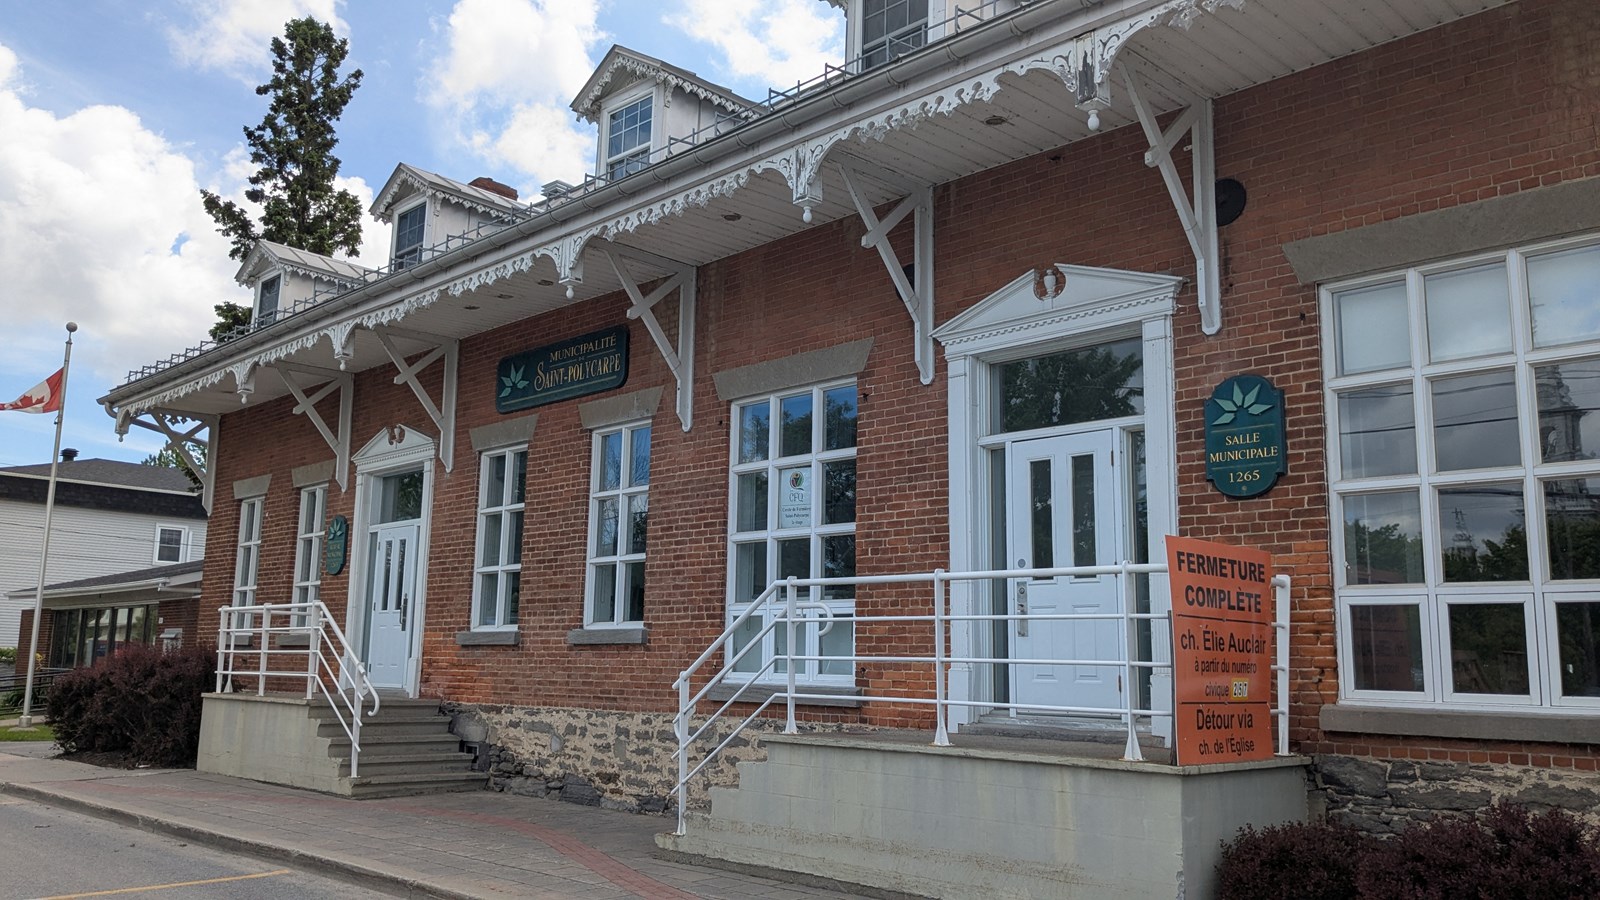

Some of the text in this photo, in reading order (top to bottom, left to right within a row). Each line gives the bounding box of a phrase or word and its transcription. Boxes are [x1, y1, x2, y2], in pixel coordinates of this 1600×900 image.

[549, 333, 617, 363] MUNICIPALITÉ
[534, 353, 621, 391] SAINT-POLYCARPE
[1225, 432, 1260, 446] SALLE
[1210, 446, 1278, 463] MUNICIPALE
[1229, 470, 1260, 483] 1265
[1176, 551, 1265, 583] FERMETURE
[1185, 585, 1261, 613] COMPLÈTE
[1180, 625, 1266, 654] ch. Élie Auclair
[1195, 656, 1257, 675] à partir du numéro
[1205, 681, 1229, 700] civique
[1196, 708, 1253, 730] Détour via
[1199, 734, 1255, 756] ch. de l'Église
